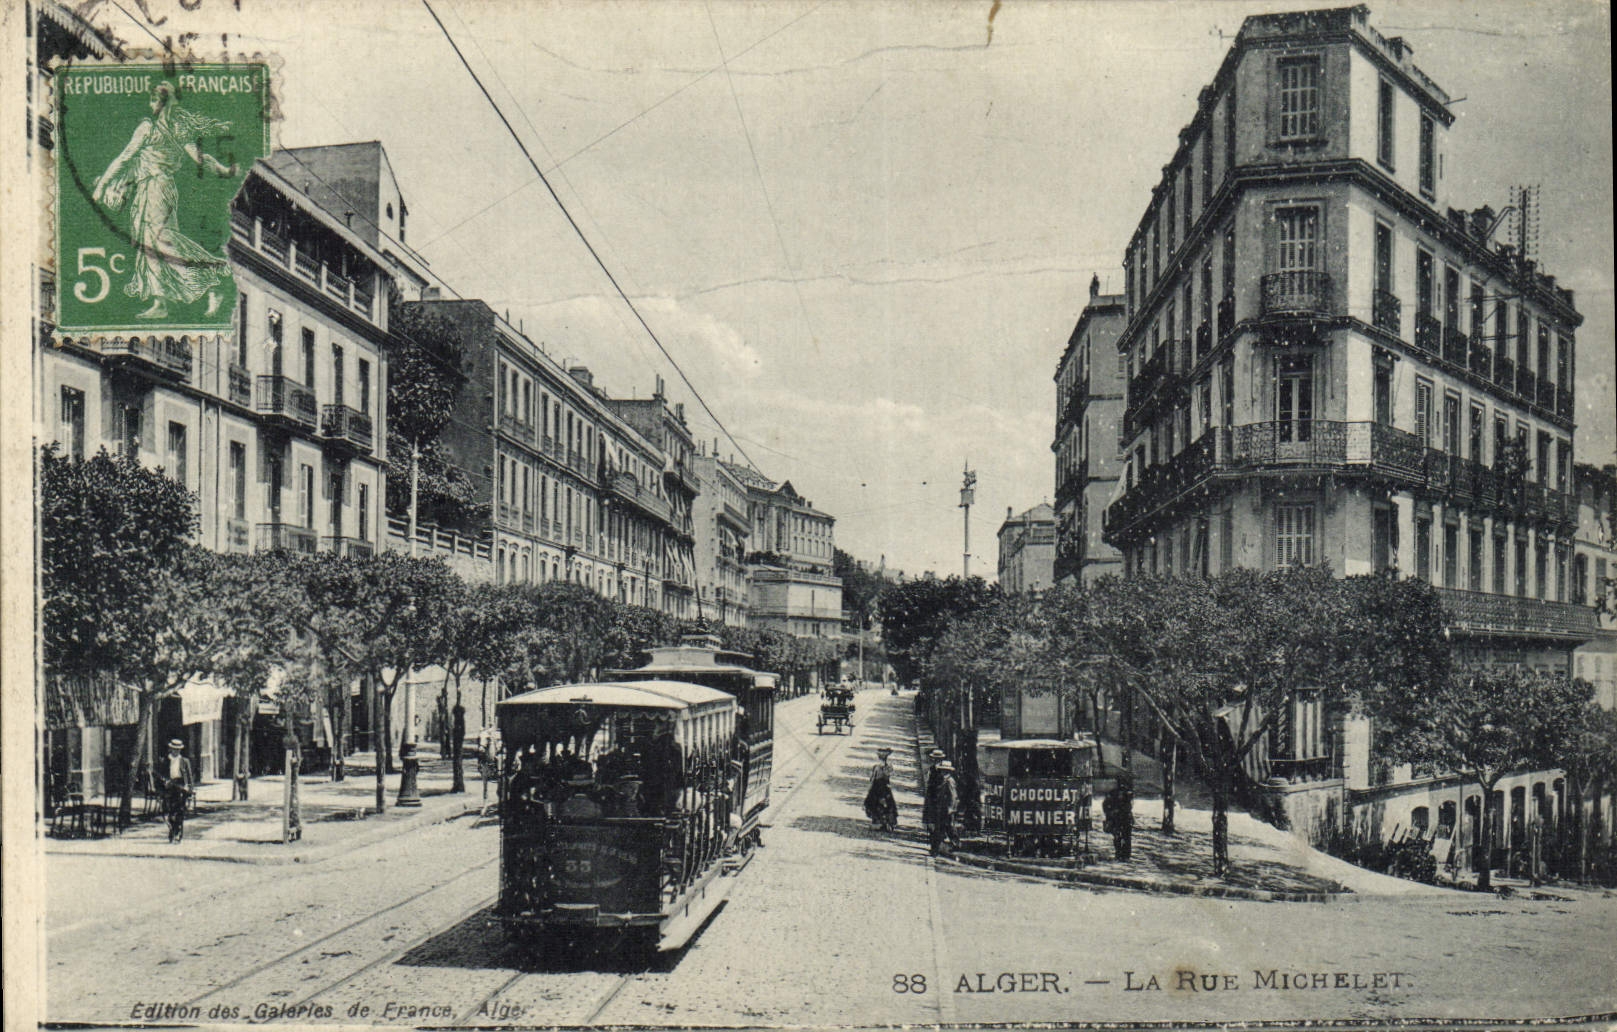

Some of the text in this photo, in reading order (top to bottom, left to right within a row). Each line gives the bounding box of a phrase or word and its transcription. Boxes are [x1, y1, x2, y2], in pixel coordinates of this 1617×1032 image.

[64, 74, 259, 96] REPUBLIQUE FRANÇAISE
[1010, 788, 1078, 804] CHOCOLAT
[1008, 810, 1076, 825] MENIER
